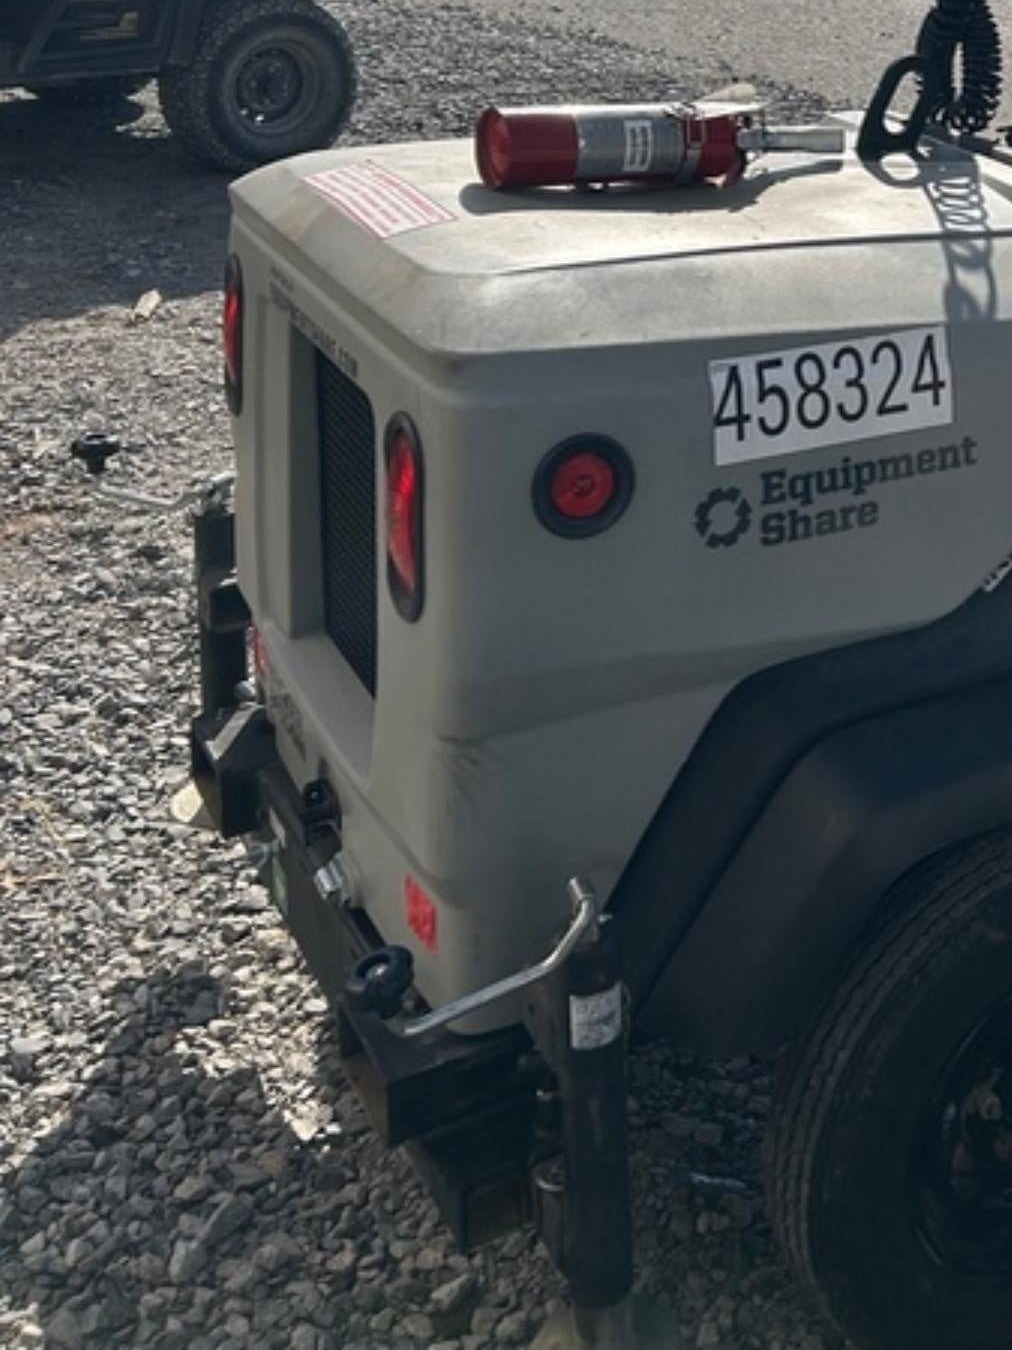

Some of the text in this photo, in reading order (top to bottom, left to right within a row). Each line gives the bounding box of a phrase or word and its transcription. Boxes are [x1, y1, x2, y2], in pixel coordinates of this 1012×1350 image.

[713, 333, 946, 442] 458324
[760, 436, 978, 505] Equipment
[760, 500, 880, 547] Share
